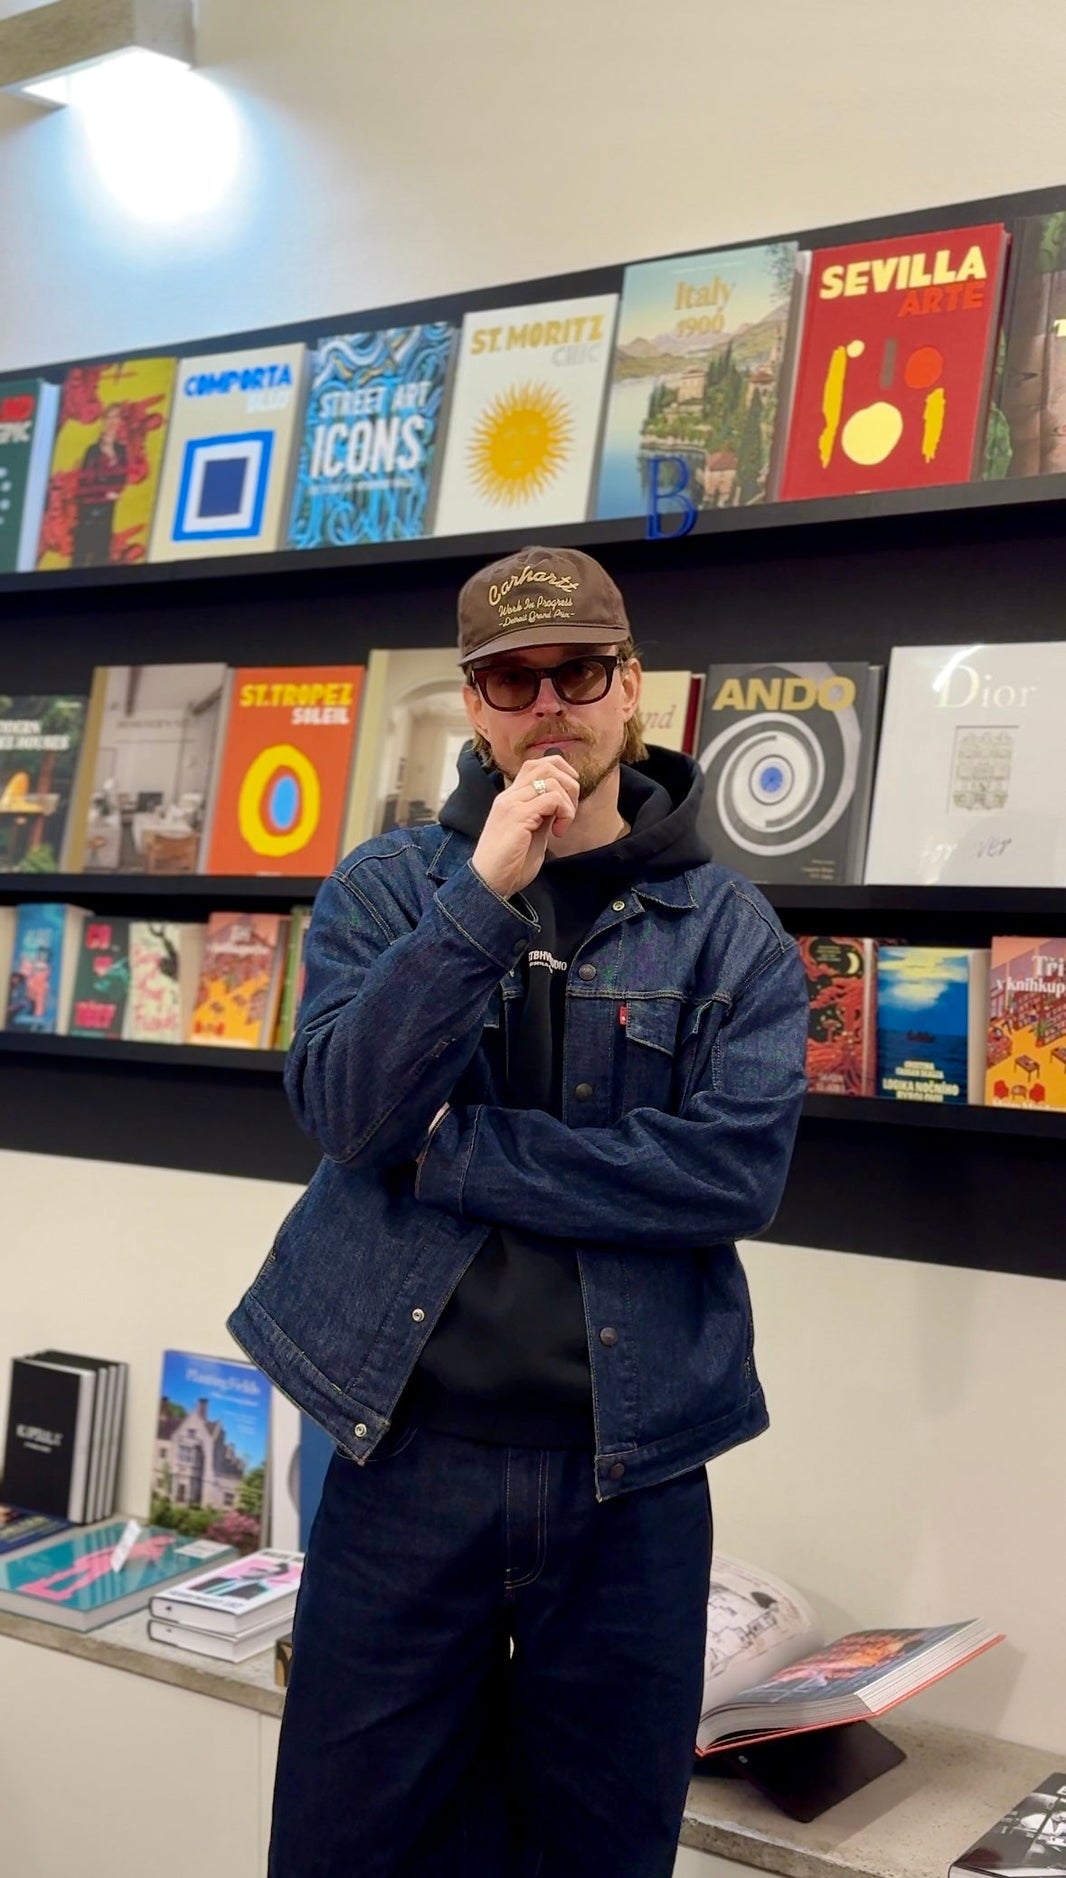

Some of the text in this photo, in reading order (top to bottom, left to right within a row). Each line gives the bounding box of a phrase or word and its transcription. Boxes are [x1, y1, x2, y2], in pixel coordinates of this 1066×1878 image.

[819, 246, 987, 299] SEVILLA
[674, 275, 736, 312] Italy
[898, 281, 985, 317] ARTE
[505, 313, 604, 352] MORITZ
[676, 315, 726, 338] 1900
[551, 343, 601, 368] CHIC
[184, 363, 293, 397] COMPORTA
[319, 382, 432, 419] STREET ART
[310, 415, 425, 479] ICONS
[646, 454, 698, 541] B
[489, 566, 579, 606] Carhartt
[499, 595, 573, 617] Work In Progress
[528, 611, 551, 623] Grand
[711, 676, 856, 711] ANDO
[934, 664, 1037, 708] Dior
[291, 707, 350, 726] SOLEIL
[1032, 955, 1065, 977] Tři
[882, 1078, 959, 1096] LOGIKA NOČNÍHO
